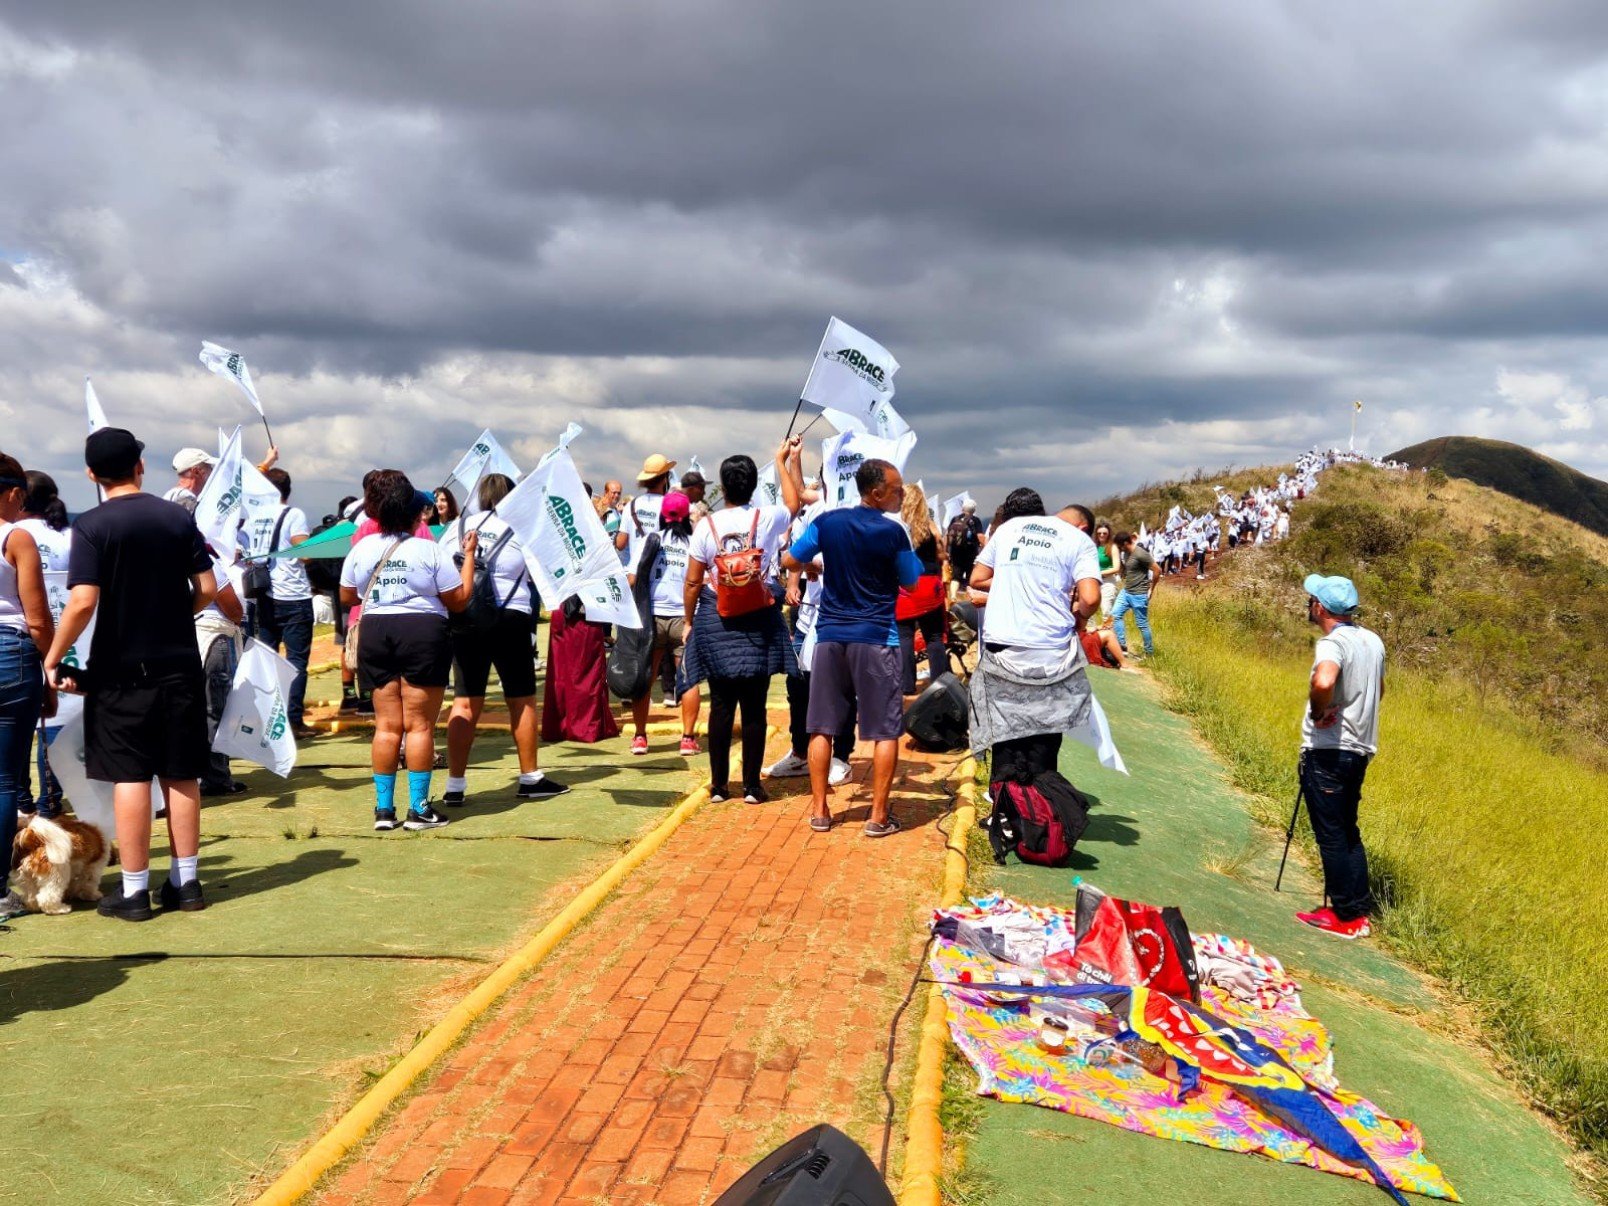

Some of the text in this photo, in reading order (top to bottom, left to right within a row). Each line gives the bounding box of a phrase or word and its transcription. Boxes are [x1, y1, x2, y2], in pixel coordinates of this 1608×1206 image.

[836, 348, 885, 383] ABRACE
[839, 471, 859, 482] Apo
[546, 505, 561, 530] SERRA
[557, 527, 565, 539] DA
[548, 495, 586, 560] ABRACE
[1022, 523, 1058, 536] ABRACE
[1017, 535, 1052, 549] Apoio
[659, 558, 685, 568] Apoio
[376, 576, 408, 587] Apoio
